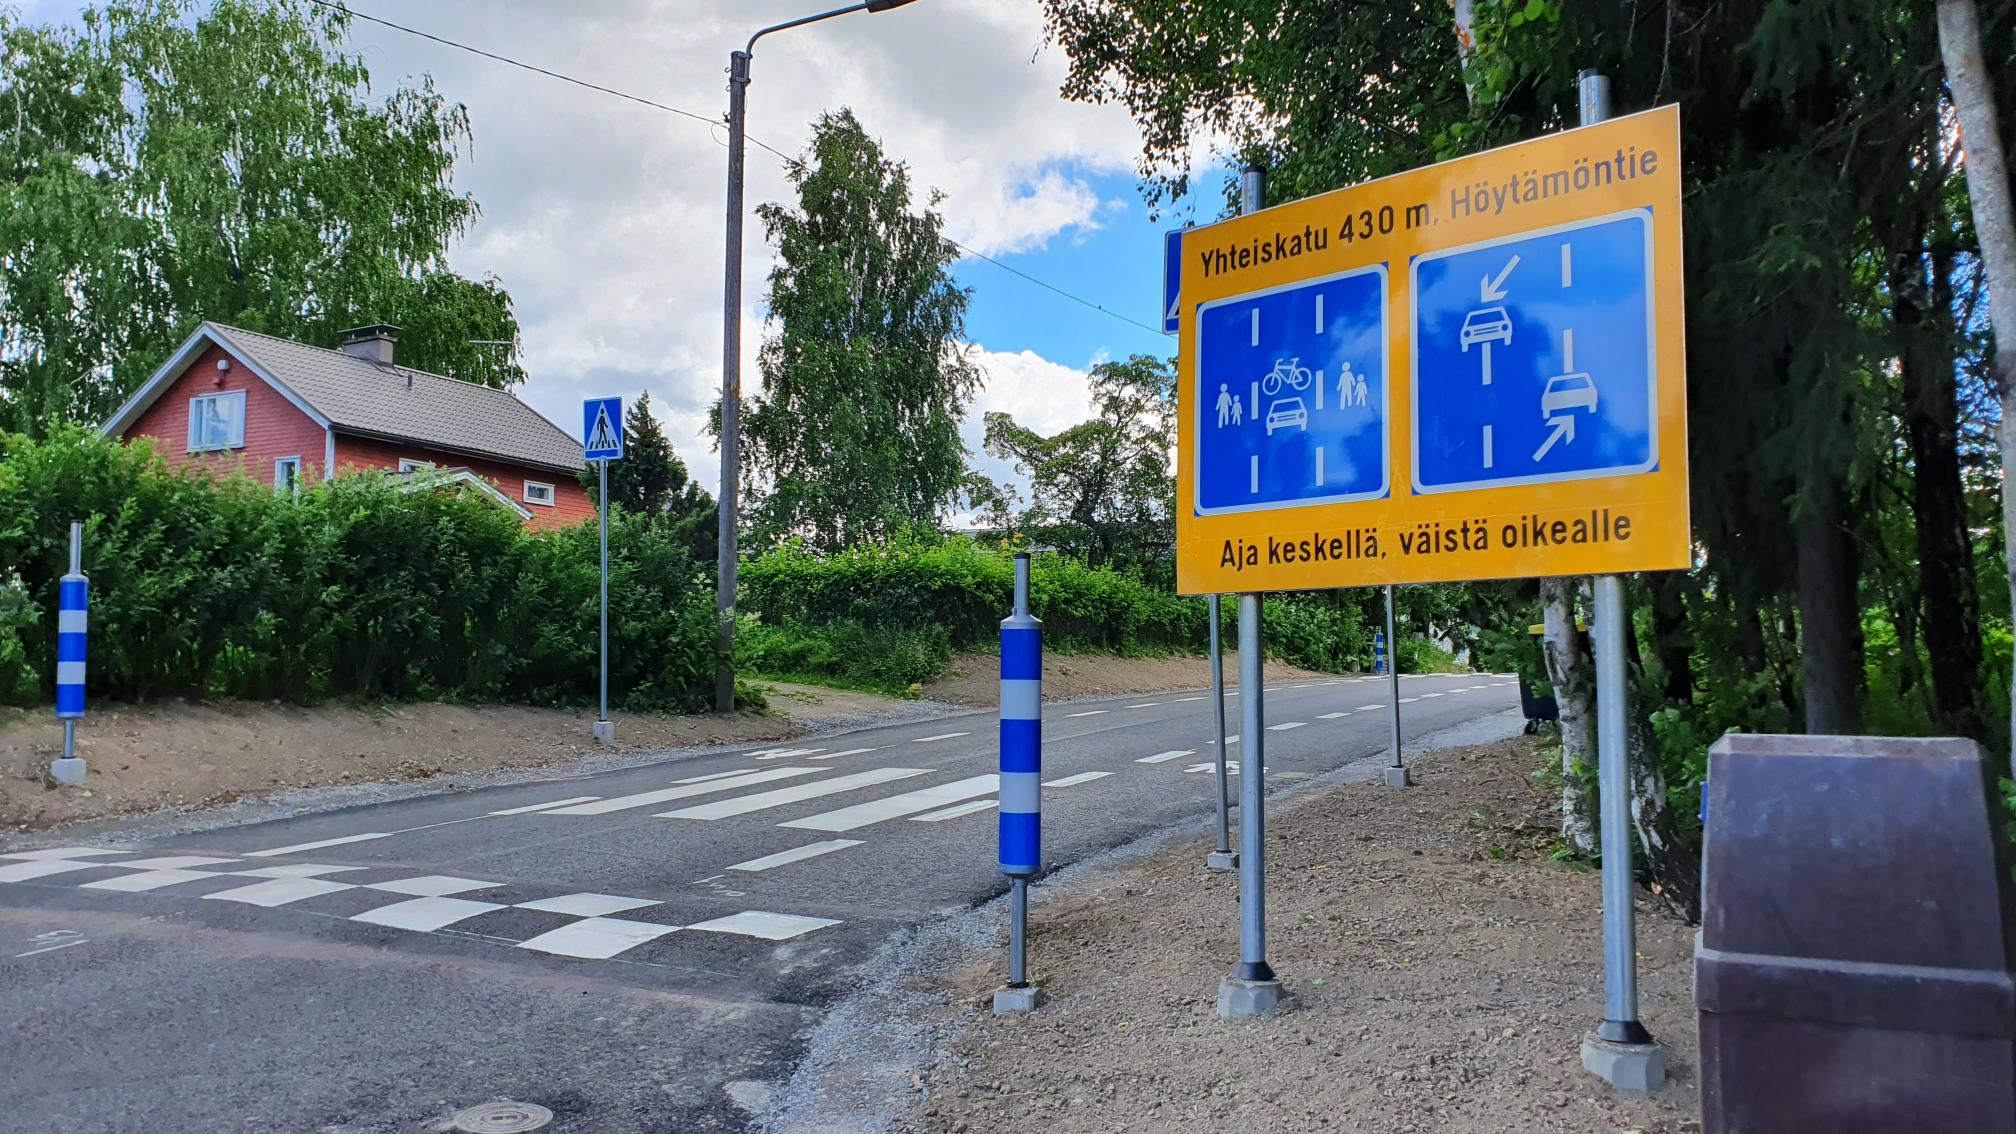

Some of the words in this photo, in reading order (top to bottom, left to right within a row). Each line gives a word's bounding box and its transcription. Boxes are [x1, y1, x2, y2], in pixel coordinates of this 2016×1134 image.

[1200, 224, 1328, 278] Yhteiskatu
[1338, 205, 1395, 243] 430
[1405, 202, 1439, 230] m,
[1450, 146, 1659, 219] Höytämöntie
[1219, 538, 1259, 572] Aja
[1267, 527, 1387, 565] keskellä,
[1398, 518, 1489, 556] väistä
[1501, 508, 1632, 549] oikealle
